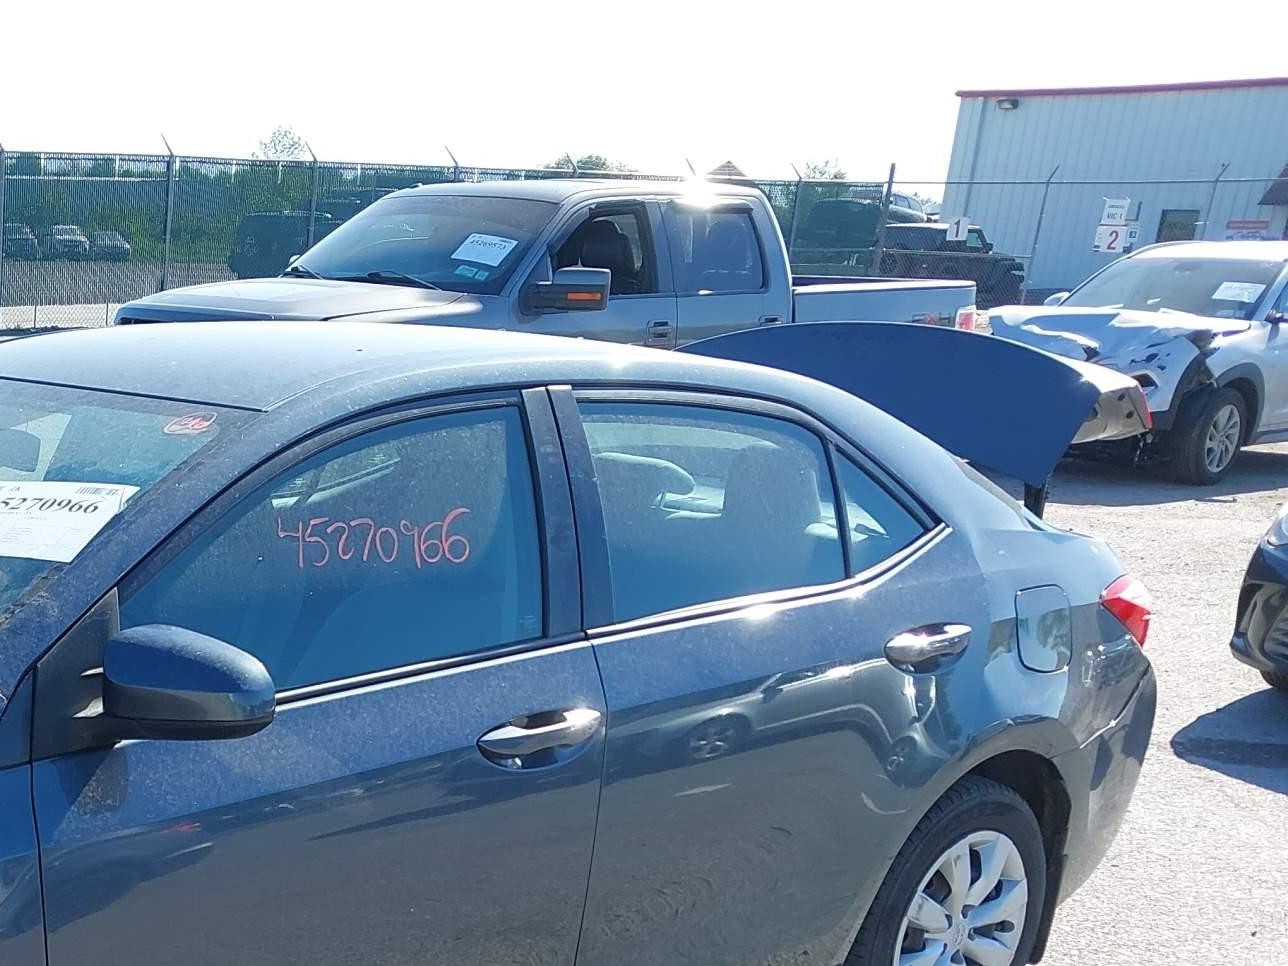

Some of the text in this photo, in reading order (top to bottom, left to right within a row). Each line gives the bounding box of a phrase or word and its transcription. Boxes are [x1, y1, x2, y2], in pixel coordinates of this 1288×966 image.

[954, 218, 961, 238] 1
[1106, 230, 1119, 250] 2
[277, 506, 472, 568] 45270966
